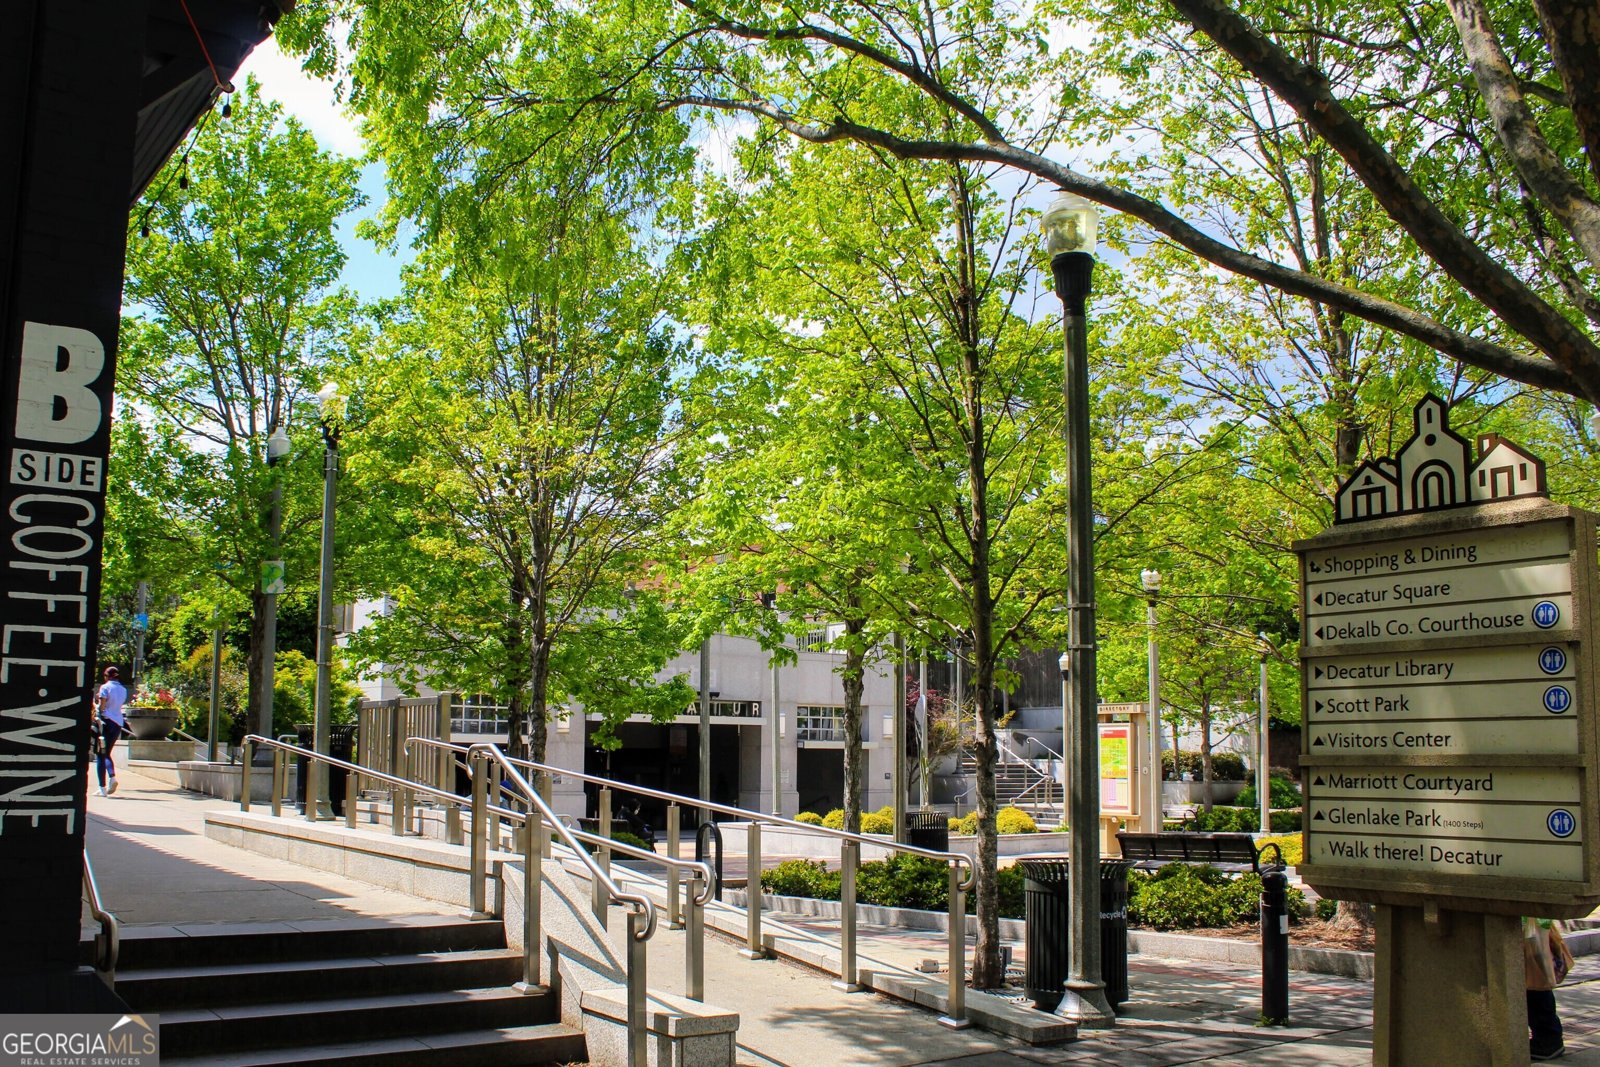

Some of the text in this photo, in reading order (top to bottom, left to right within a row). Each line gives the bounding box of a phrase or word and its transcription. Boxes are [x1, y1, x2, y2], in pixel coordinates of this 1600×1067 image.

[15, 321, 105, 444] B
[17, 453, 96, 486] SIDE
[1324, 553, 1399, 575] Shopping
[1404, 549, 1416, 564] &
[1421, 544, 1477, 562] Dining
[1325, 583, 1450, 606] Decatur Square
[1326, 612, 1525, 640] Dekalb Co. Courthouse
[1327, 659, 1454, 680] Decatur Library
[1327, 694, 1410, 714] Scott Park
[1328, 731, 1451, 748] Visitors Center
[1329, 772, 1493, 795] Marriott Courtyard
[1329, 807, 1483, 829] Glenlake Park (1400 Steps)
[1329, 840, 1503, 867] Walk there! Decatur
